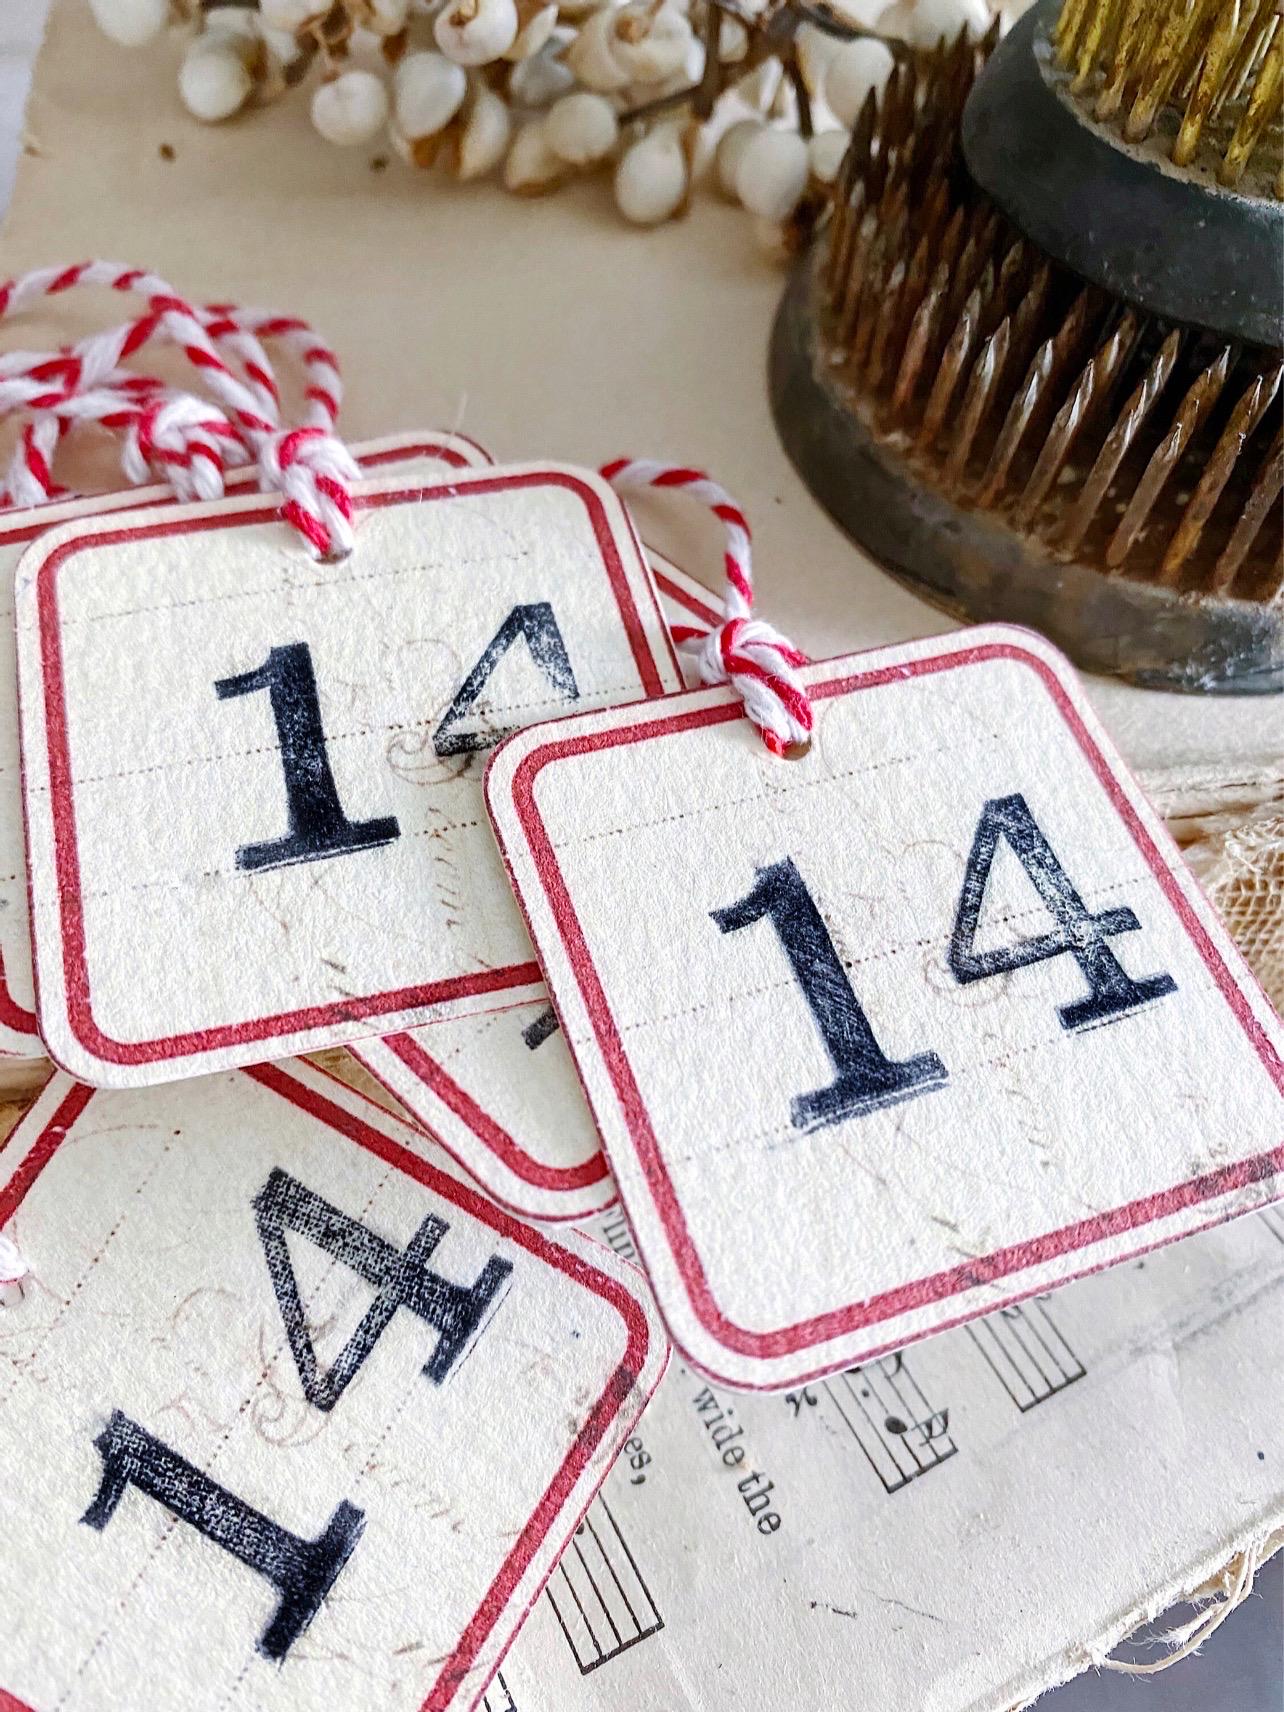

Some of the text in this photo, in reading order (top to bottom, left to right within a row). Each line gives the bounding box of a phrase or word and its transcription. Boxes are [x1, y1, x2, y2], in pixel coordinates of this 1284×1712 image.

[708, 792, 1179, 1132] 14
[78, 1167, 514, 1664] 14
[602, 1206, 782, 1535] lin wide the
[624, 1436, 652, 1485] es,
